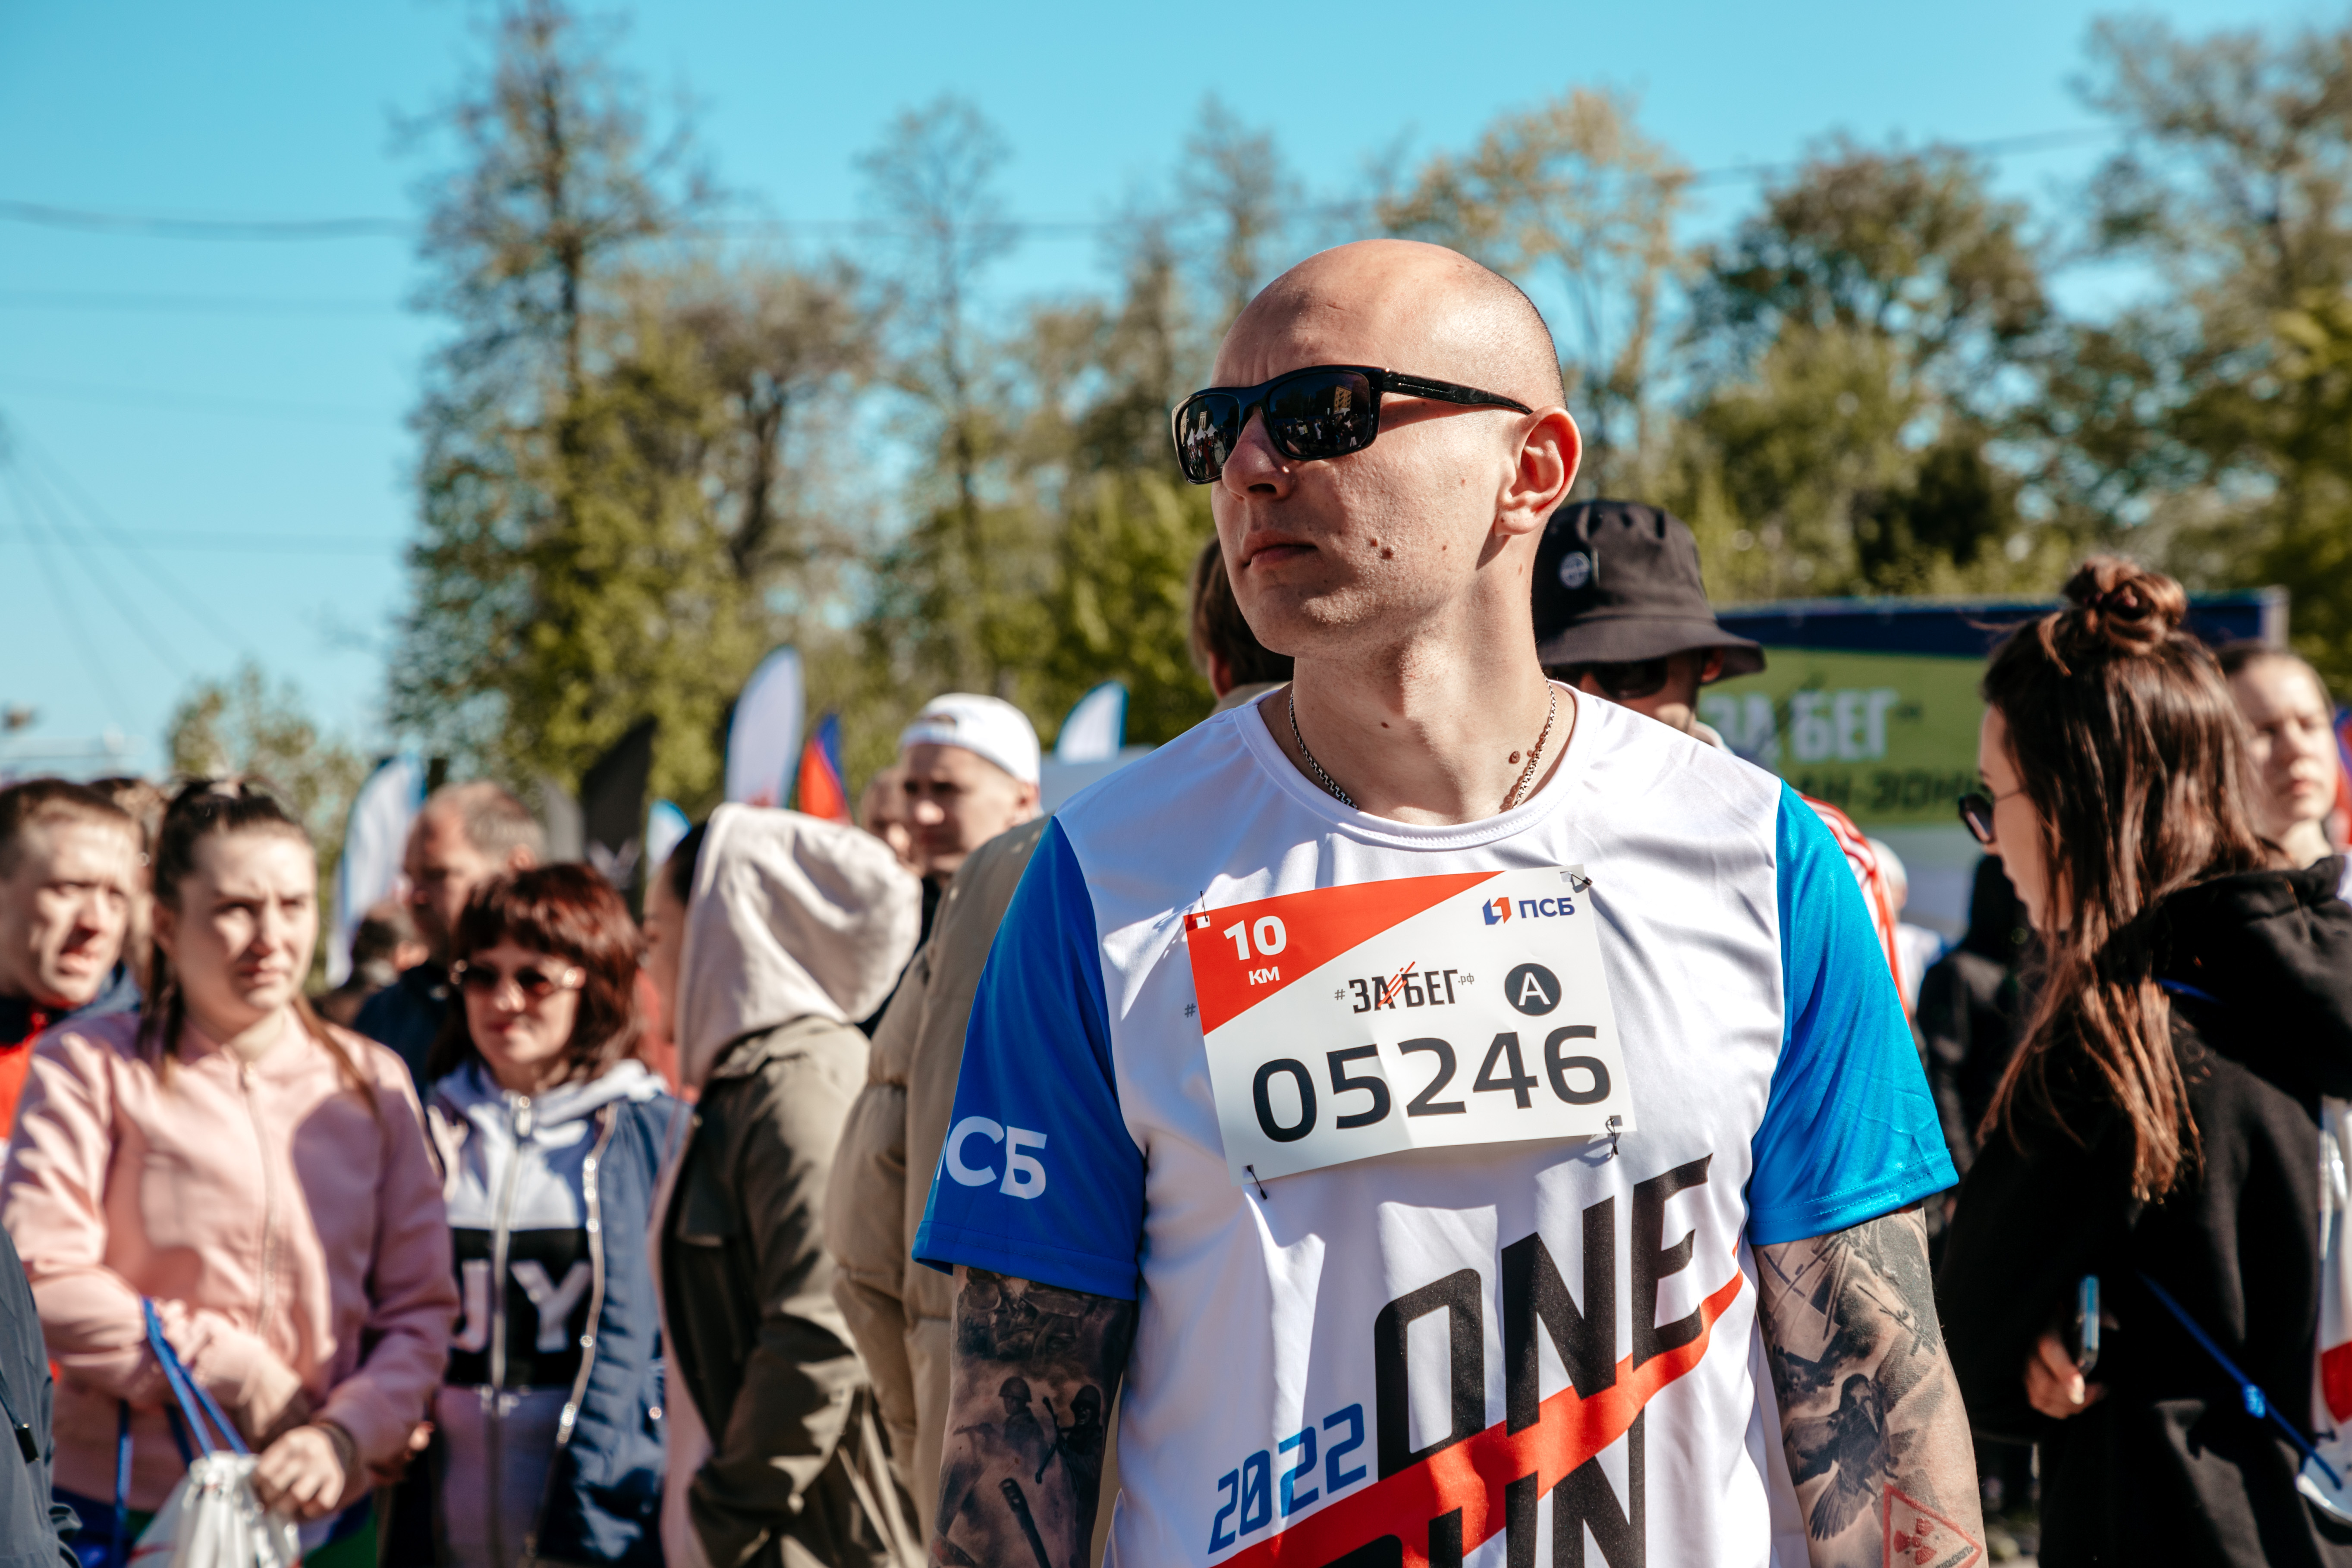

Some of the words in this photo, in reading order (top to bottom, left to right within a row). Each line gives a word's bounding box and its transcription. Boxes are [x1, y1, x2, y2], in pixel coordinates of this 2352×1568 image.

[1223, 915, 1287, 961] 10
[1519, 897, 1575, 918] ПСБ
[1248, 966, 1280, 986] КМ
[1252, 1025, 1611, 1143] 05246
[935, 1116, 1047, 1200] СБ
[1374, 1153, 1714, 1483] ONE
[1207, 1402, 1367, 1555] 2022
